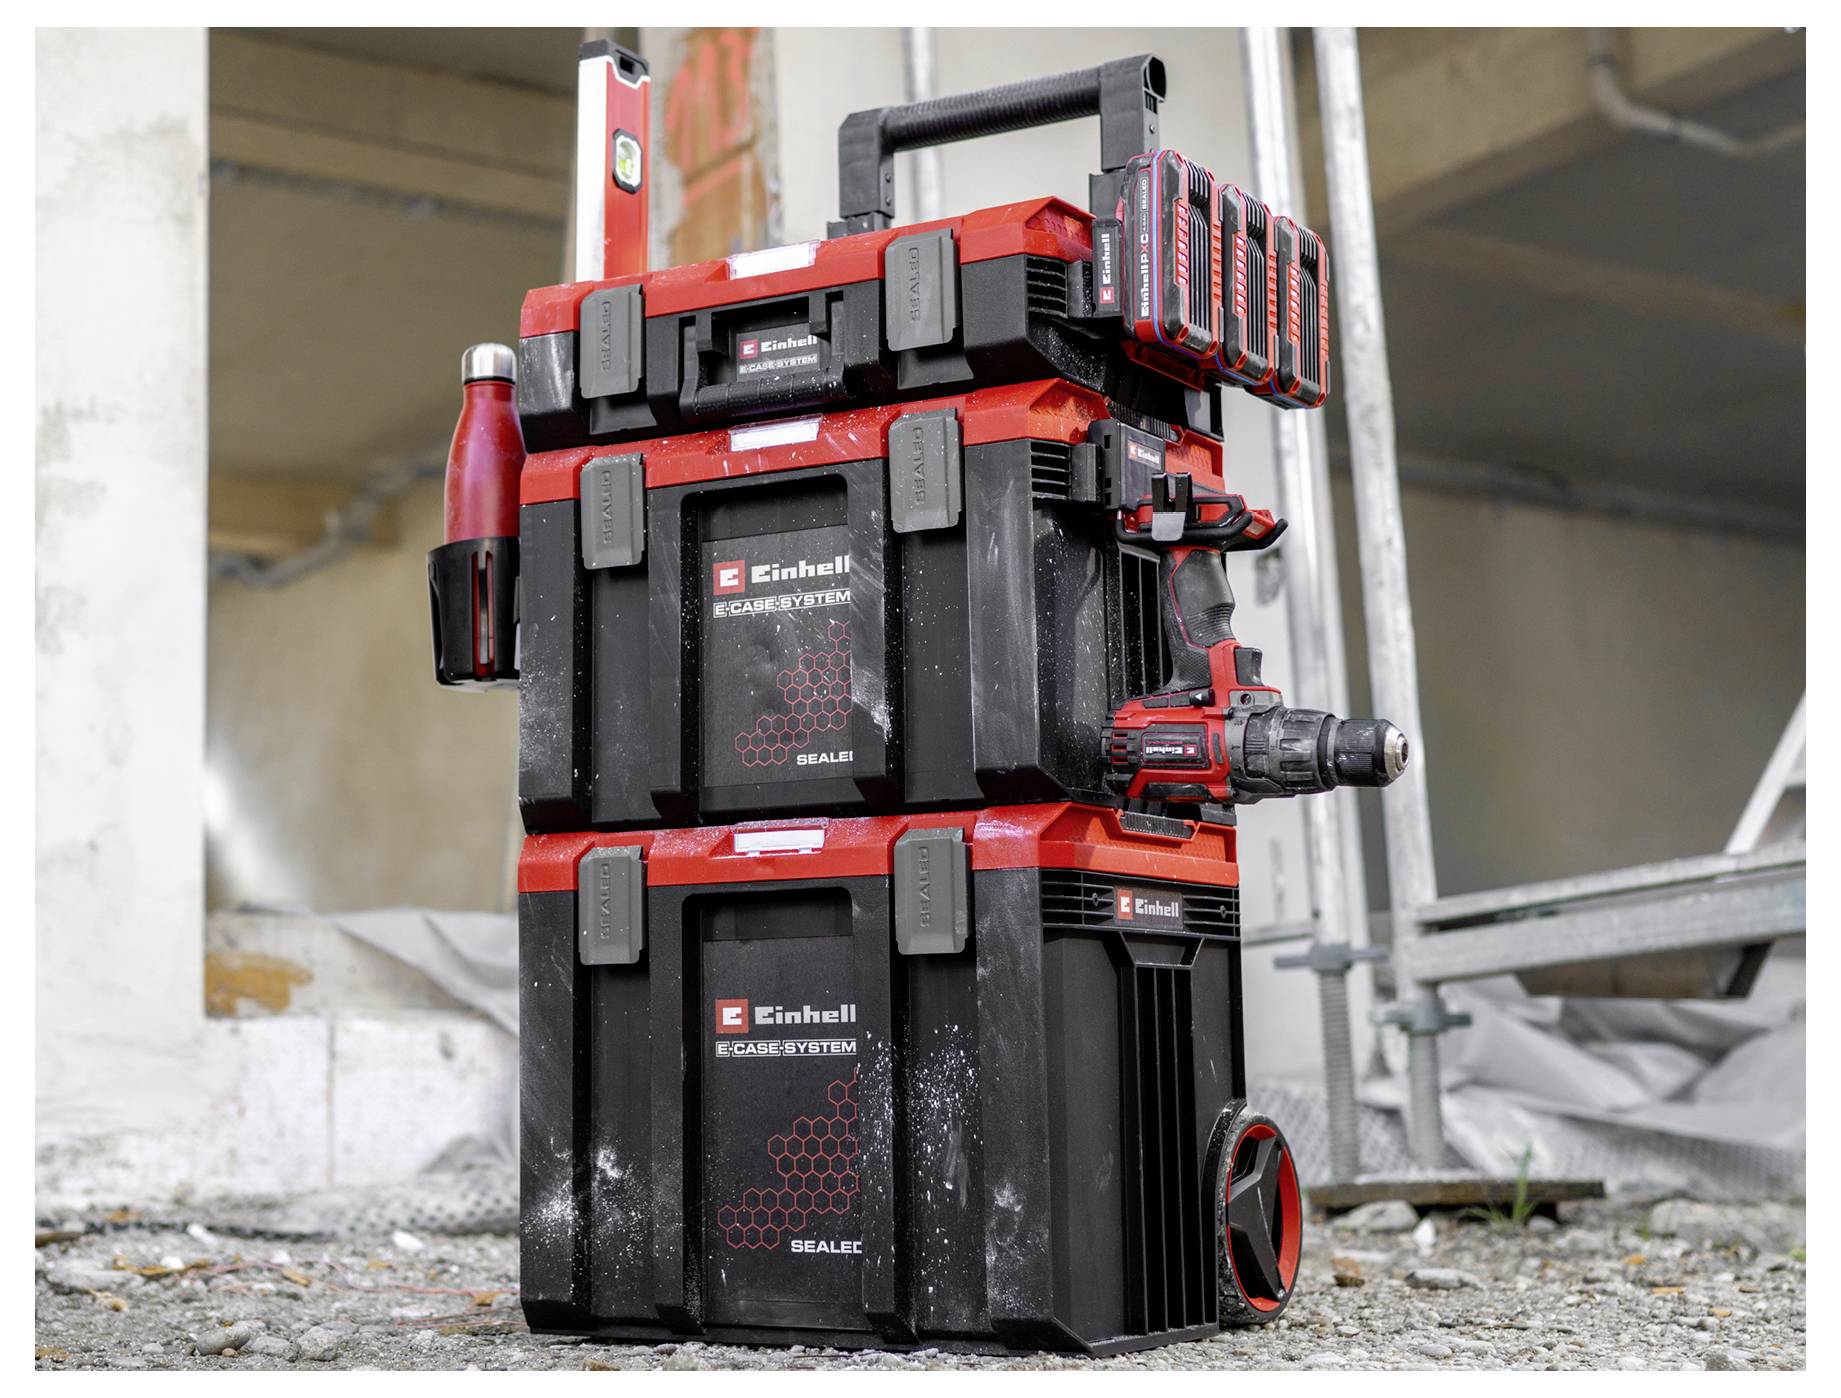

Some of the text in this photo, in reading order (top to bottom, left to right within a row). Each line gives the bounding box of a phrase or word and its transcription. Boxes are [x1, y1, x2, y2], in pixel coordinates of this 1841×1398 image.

[909, 246, 920, 322] SEALED
[1101, 233, 1111, 284] Einhell
[1140, 264, 1150, 317] Einhell
[601, 300, 612, 374] SEALED
[761, 334, 818, 353] Einhell
[914, 427, 925, 505] SEALED
[601, 470, 613, 545] SEALED
[751, 554, 850, 584] Einhell
[600, 863, 612, 940] SEALED
[919, 846, 931, 929] SEALED
[1135, 898, 1179, 918] Einhell
[755, 1004, 856, 1025] Einhell
